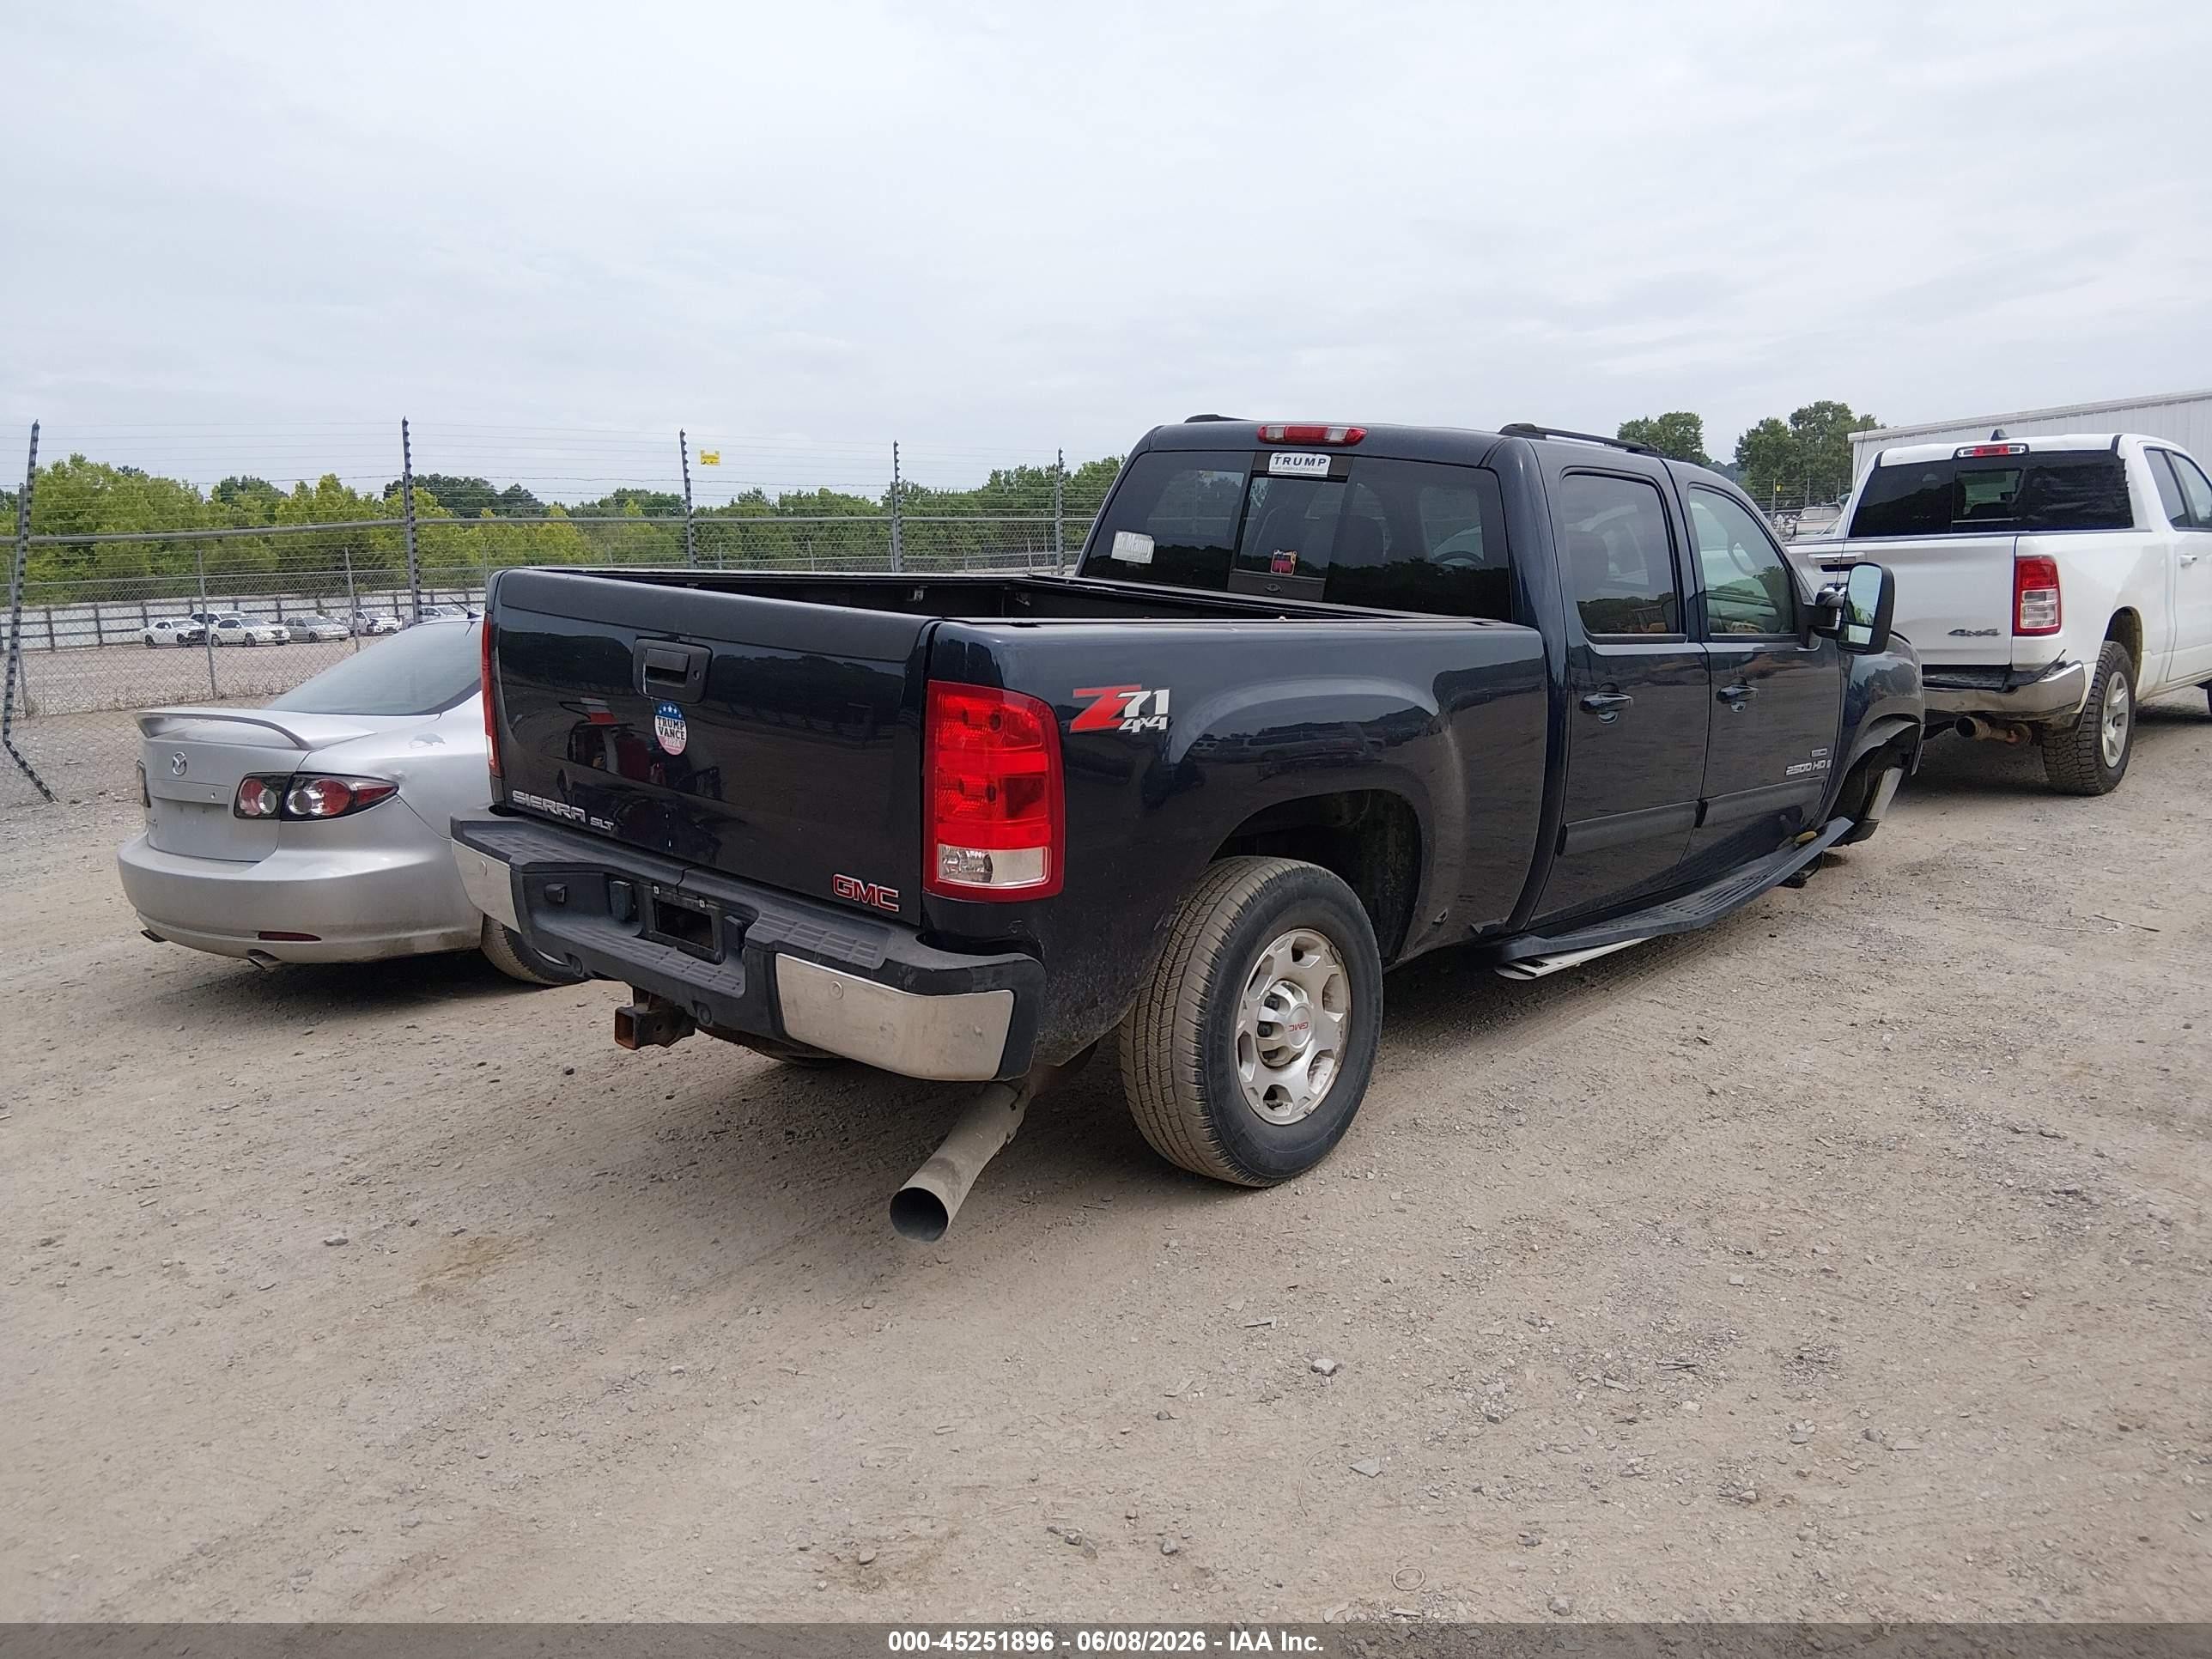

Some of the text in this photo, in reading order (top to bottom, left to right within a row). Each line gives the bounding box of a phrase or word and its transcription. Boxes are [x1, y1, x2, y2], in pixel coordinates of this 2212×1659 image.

[1274, 456, 1327, 466] TRUMP
[1070, 684, 1170, 732] Z71
[657, 716, 685, 730] TRUMP
[658, 726, 685, 740] VANCE
[512, 790, 614, 831] SIERRA SLT
[833, 873, 900, 913] GMC
